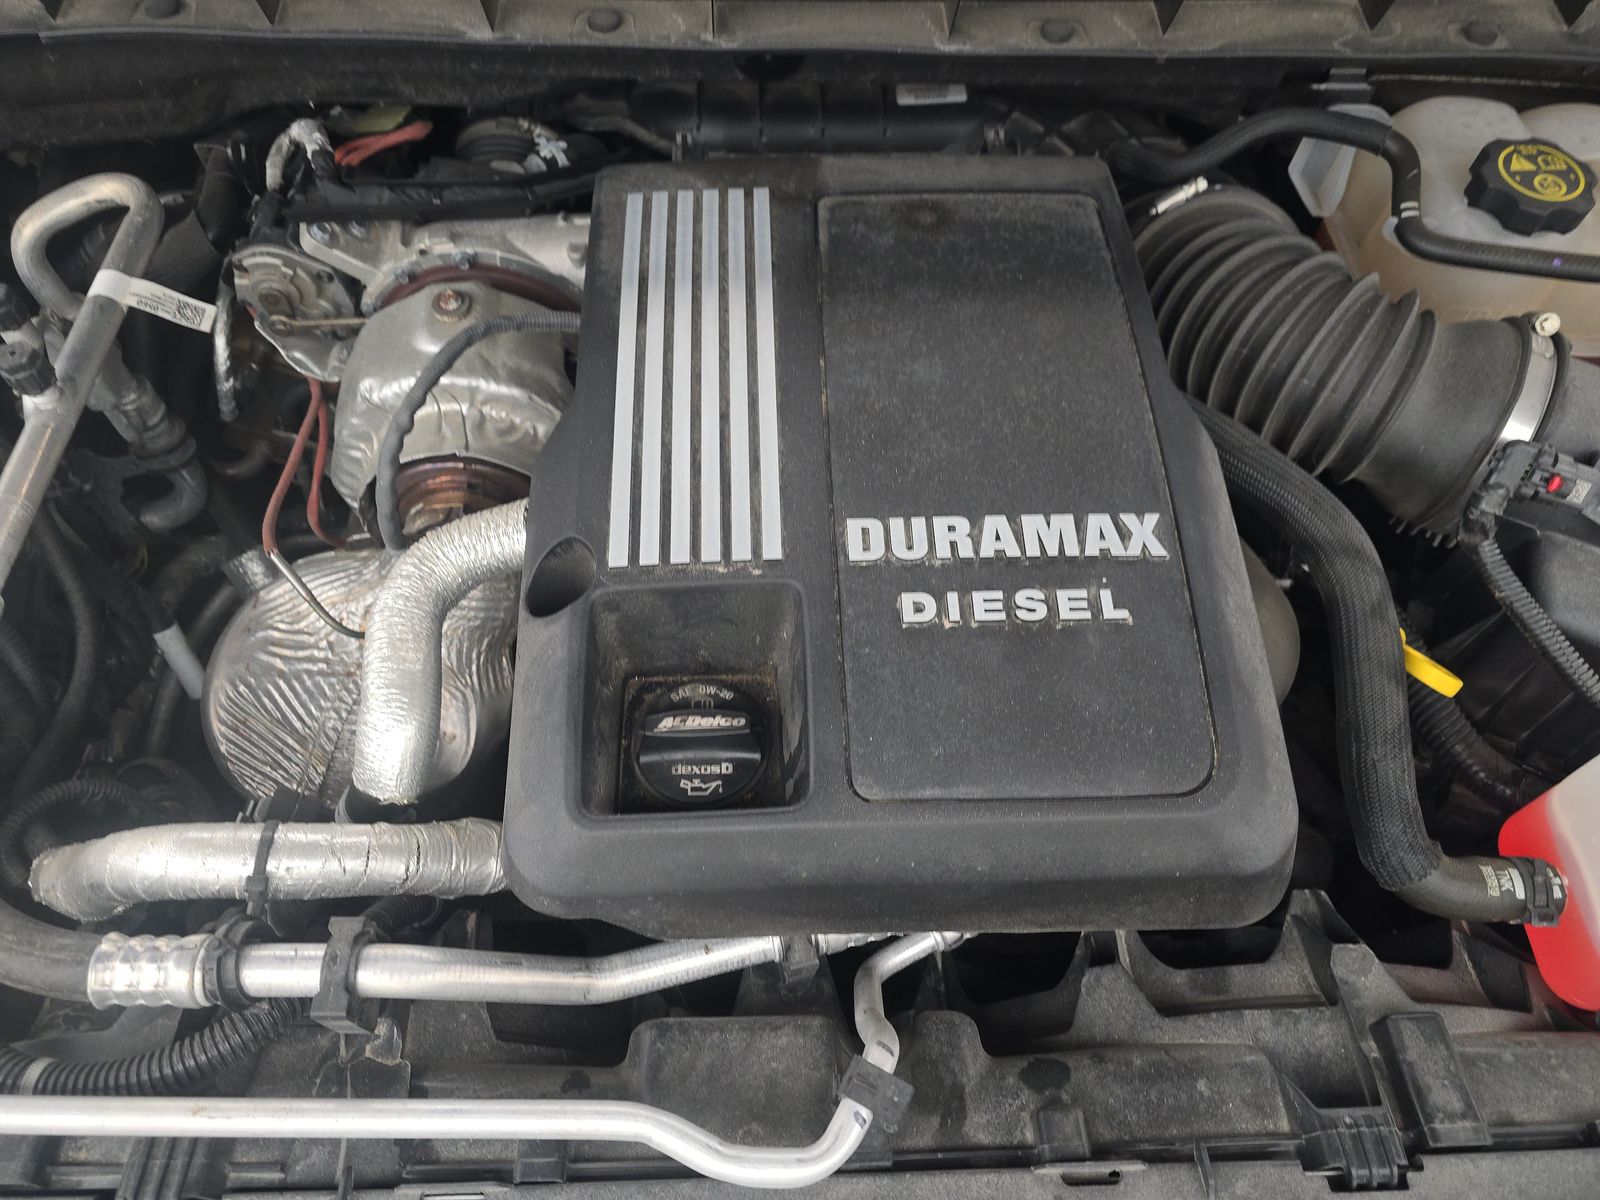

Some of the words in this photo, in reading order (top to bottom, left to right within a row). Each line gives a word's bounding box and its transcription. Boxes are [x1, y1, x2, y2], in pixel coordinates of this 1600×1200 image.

[846, 512, 1169, 562] DURAMAX
[901, 588, 1130, 623] DIESEL
[654, 714, 747, 733] ACDelco
